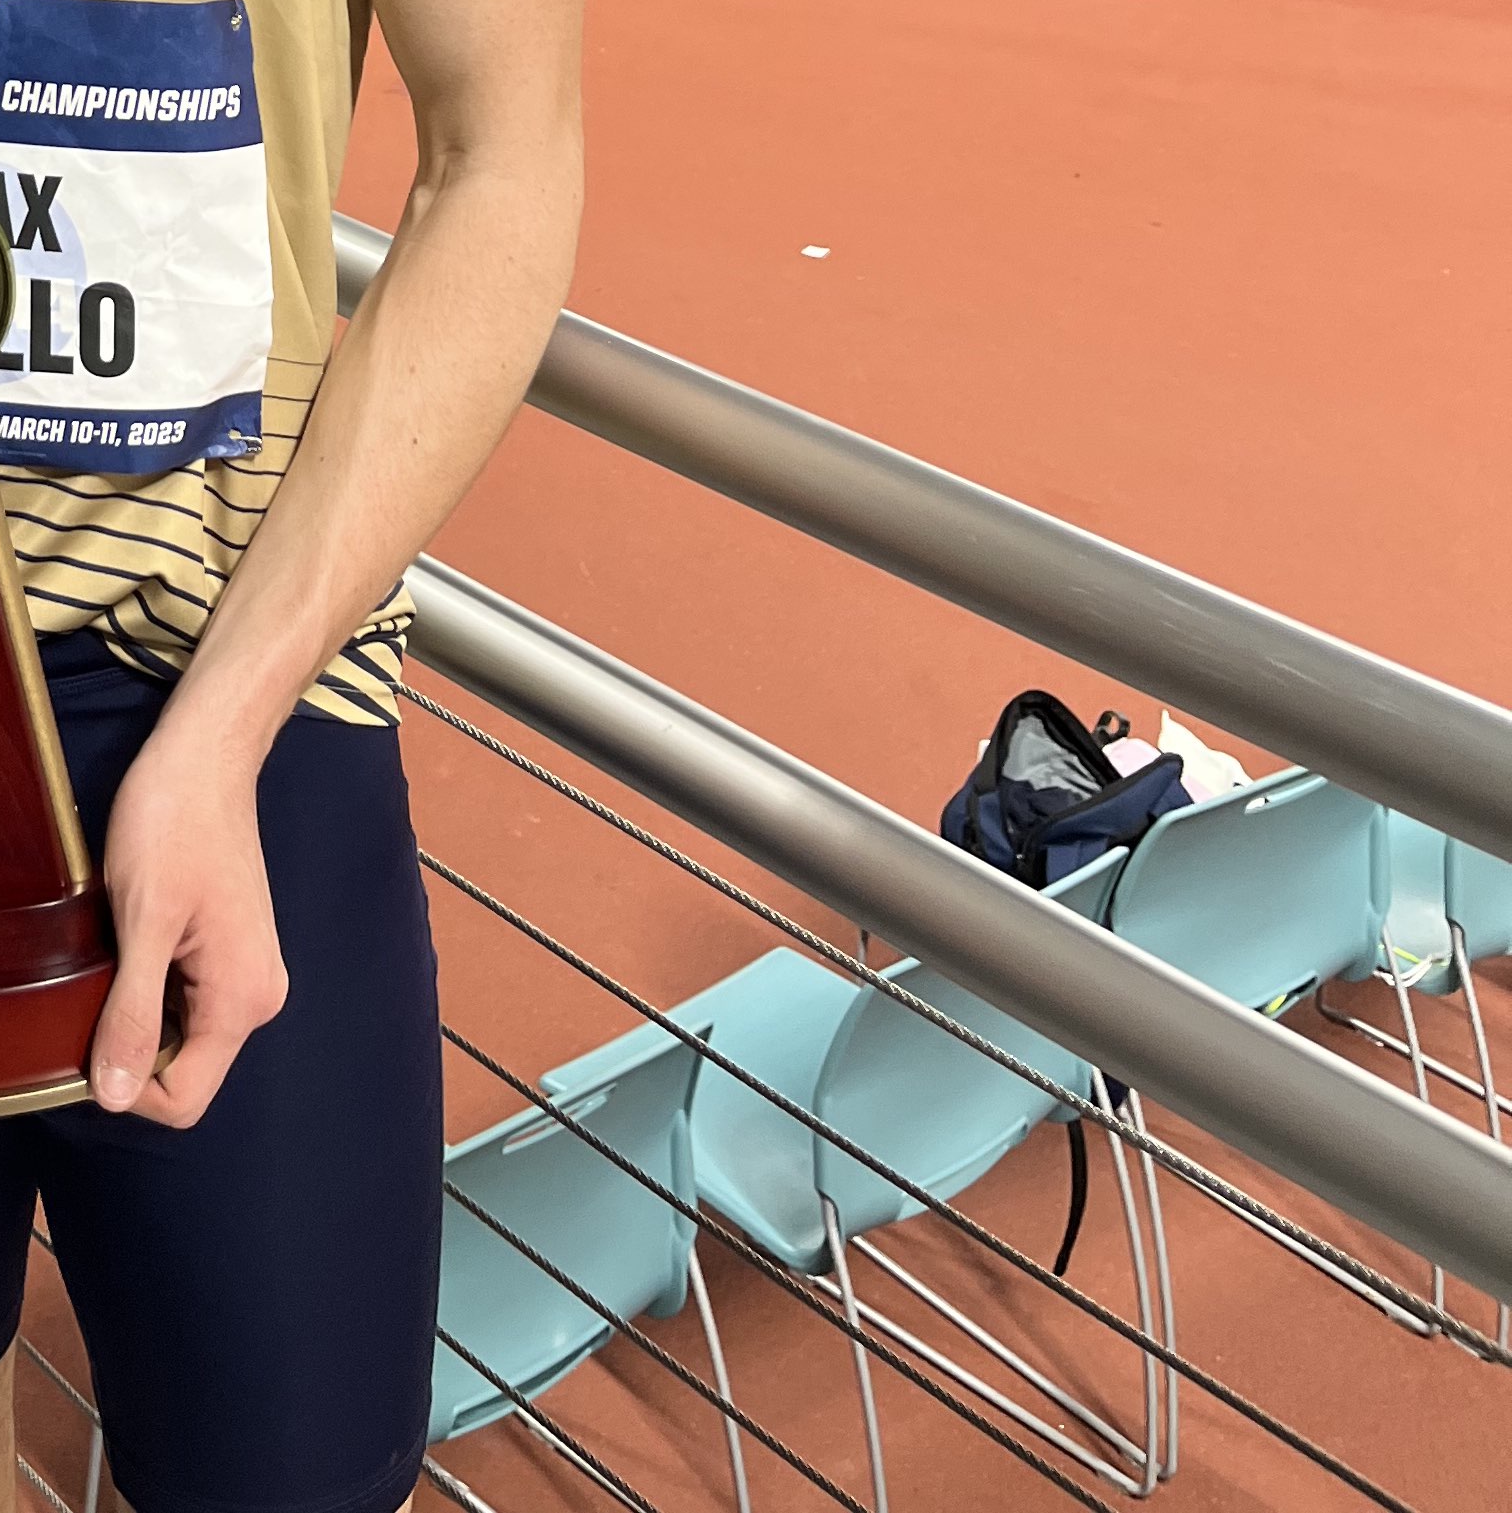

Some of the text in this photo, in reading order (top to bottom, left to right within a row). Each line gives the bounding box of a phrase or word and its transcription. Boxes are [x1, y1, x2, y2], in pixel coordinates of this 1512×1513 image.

[1, 79, 241, 122] CHAMPIONSHIPS
[69, 420, 122, 447] 10-11,
[127, 420, 186, 446] 2023
